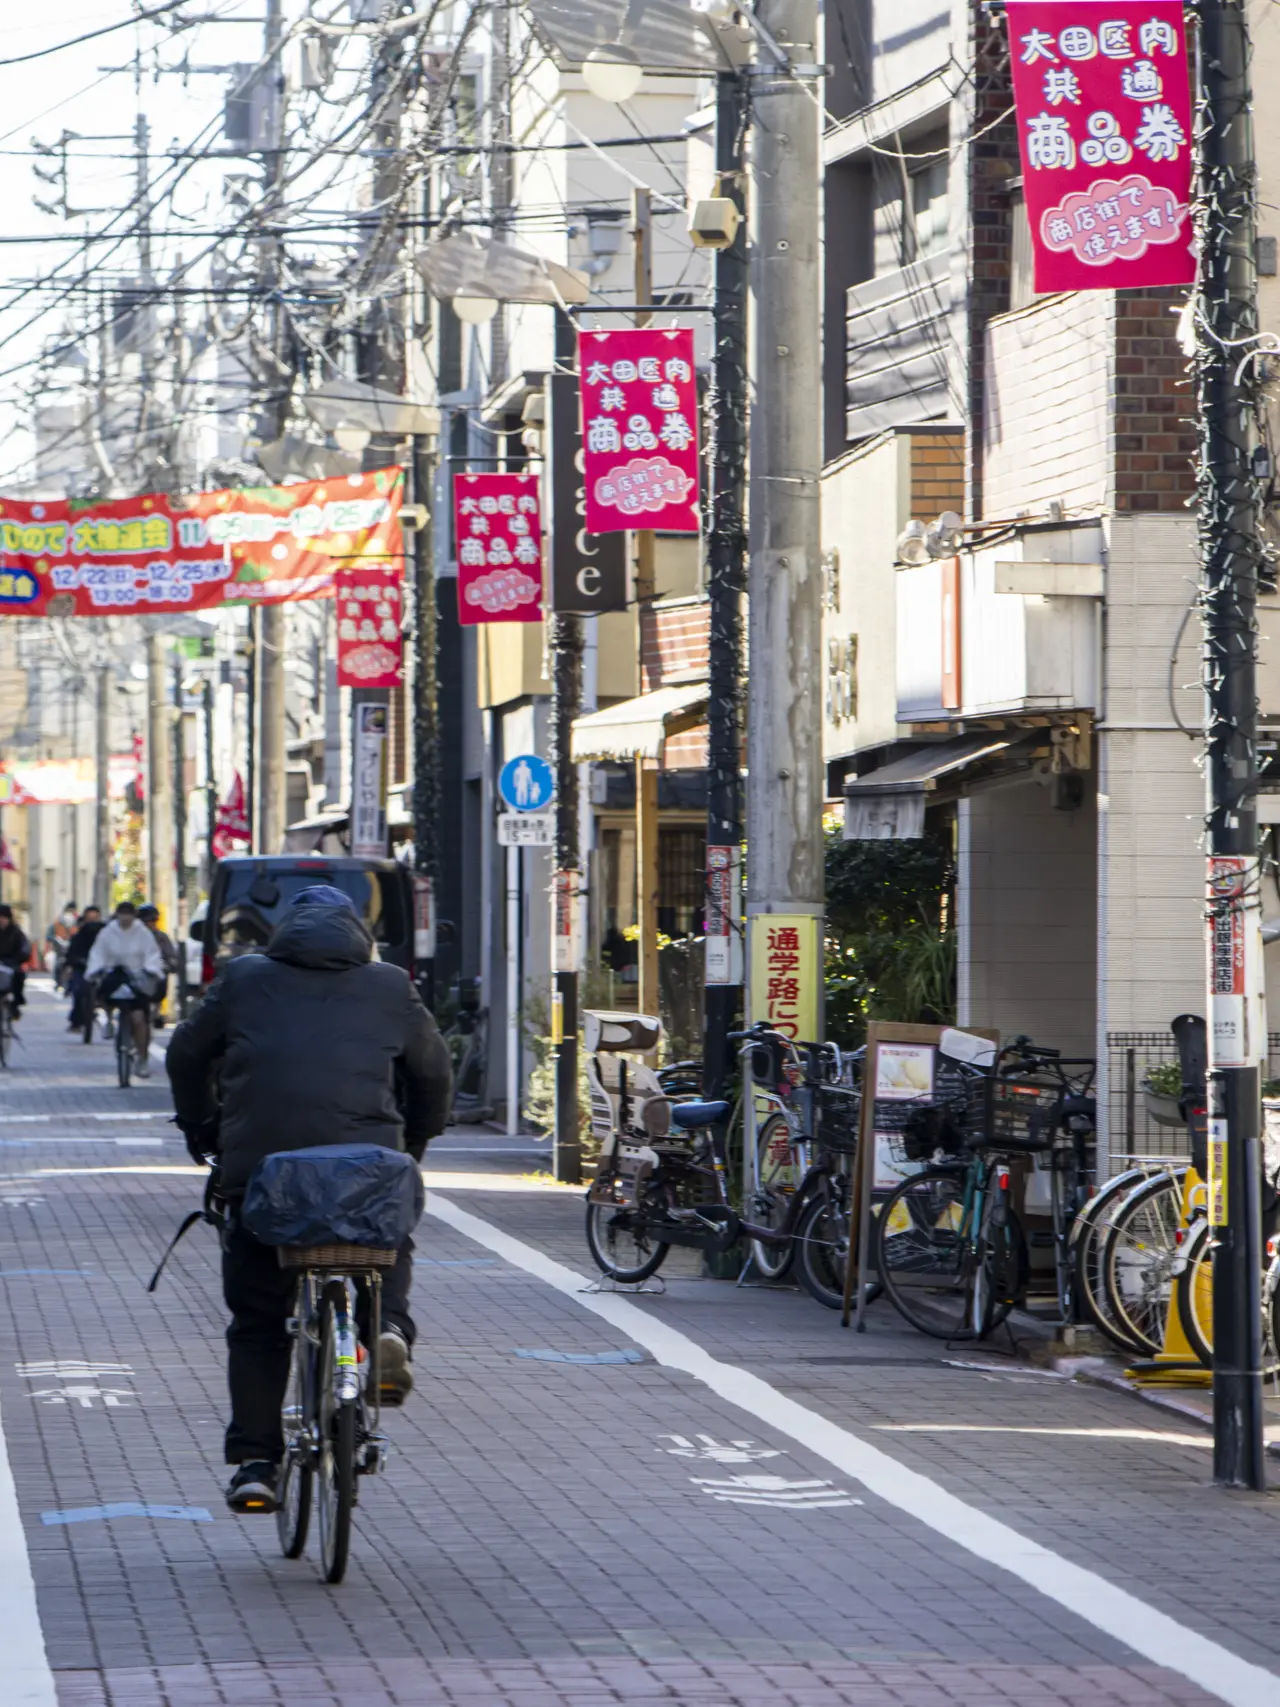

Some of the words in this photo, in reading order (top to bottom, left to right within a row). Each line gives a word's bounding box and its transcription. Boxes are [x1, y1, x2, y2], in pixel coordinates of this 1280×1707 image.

[1019, 17, 1178, 63] 大田区内
[1042, 59, 1163, 105] 共通
[1025, 102, 1188, 170] 商品券
[1046, 185, 1146, 244] 商店街で
[1081, 199, 1176, 259] 使えます!
[585, 357, 691, 386] 大田区内
[599, 383, 681, 412] 共通
[587, 411, 695, 454] 商品券
[459, 494, 537, 515] 大田区内
[460, 535, 540, 567] 商品券
